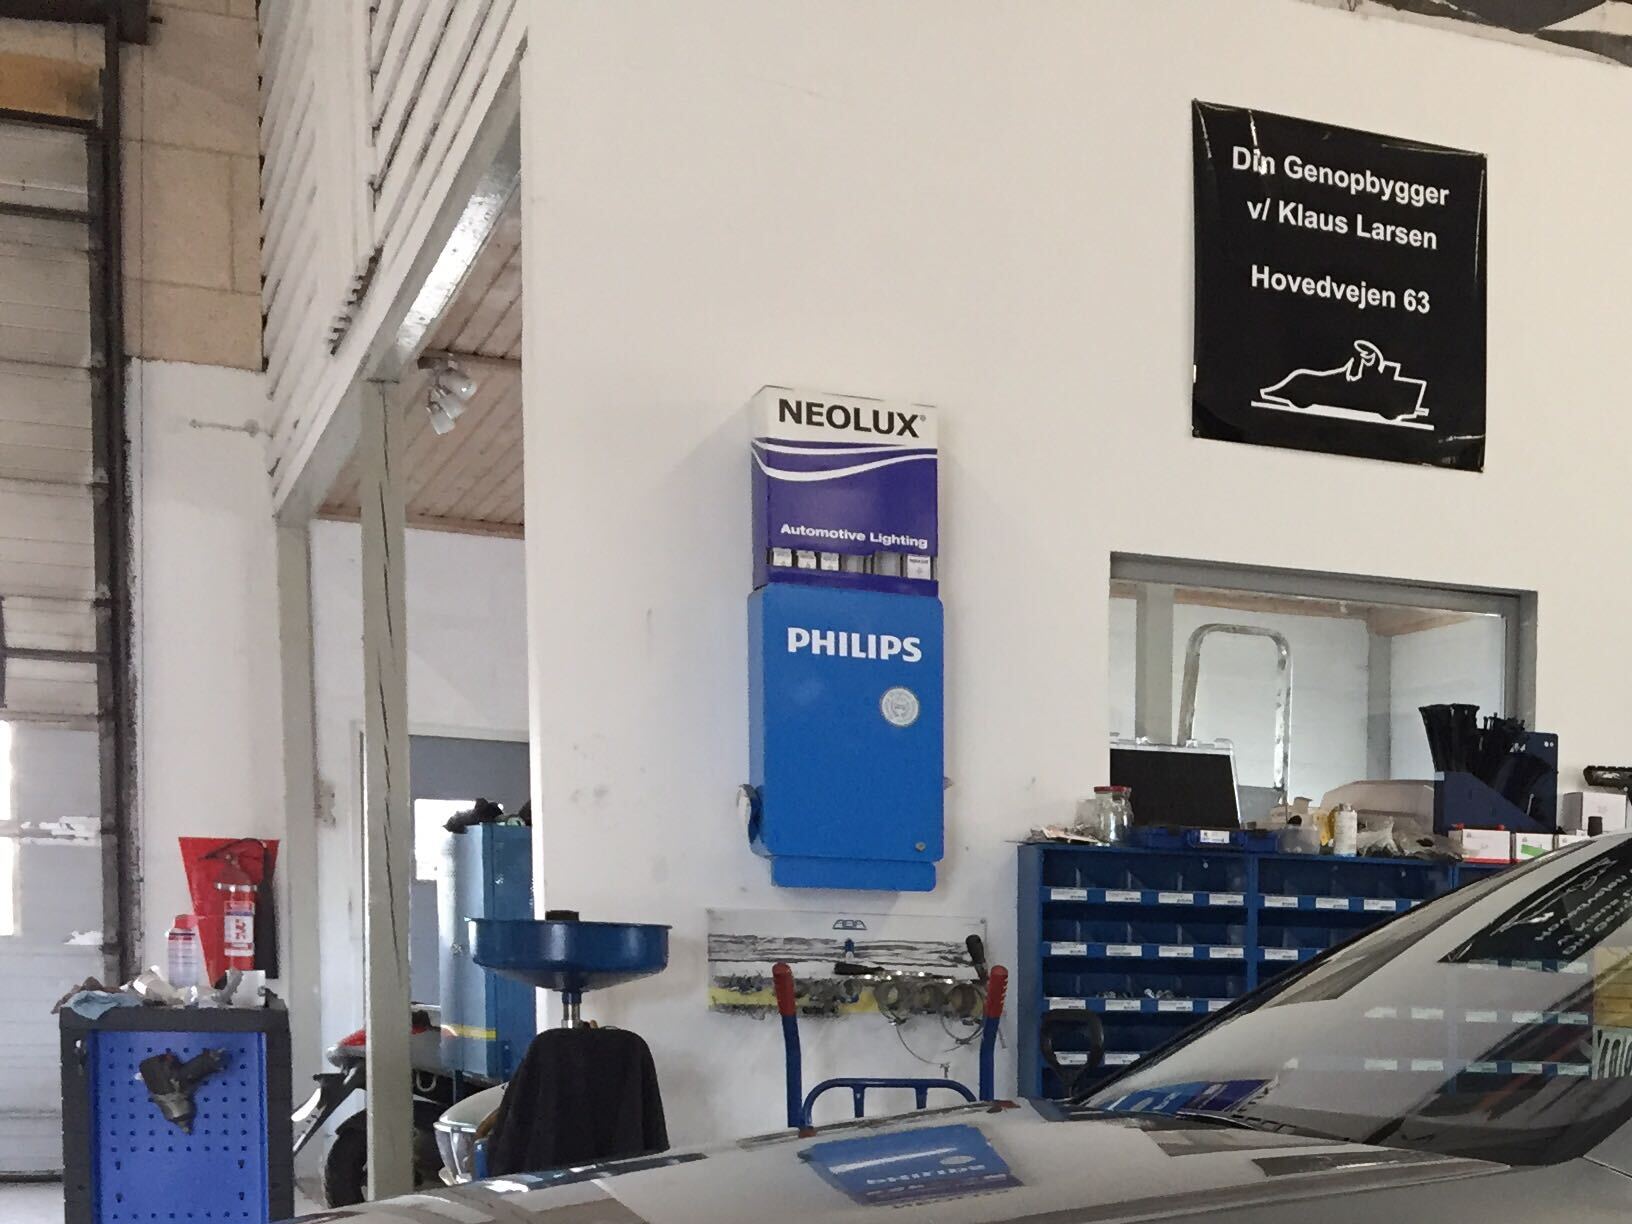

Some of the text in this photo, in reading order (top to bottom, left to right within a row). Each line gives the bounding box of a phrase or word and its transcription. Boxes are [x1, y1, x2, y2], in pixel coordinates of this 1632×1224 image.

[1232, 145, 1450, 207] Din Genopbygger
[1247, 198, 1438, 250] v/ Klaus Larsen
[1251, 264, 1431, 314] Hovedvejen 63
[778, 398, 920, 438] NEOLUX
[780, 523, 928, 549] Automotive Lighting
[787, 626, 923, 663] PHILIPS
